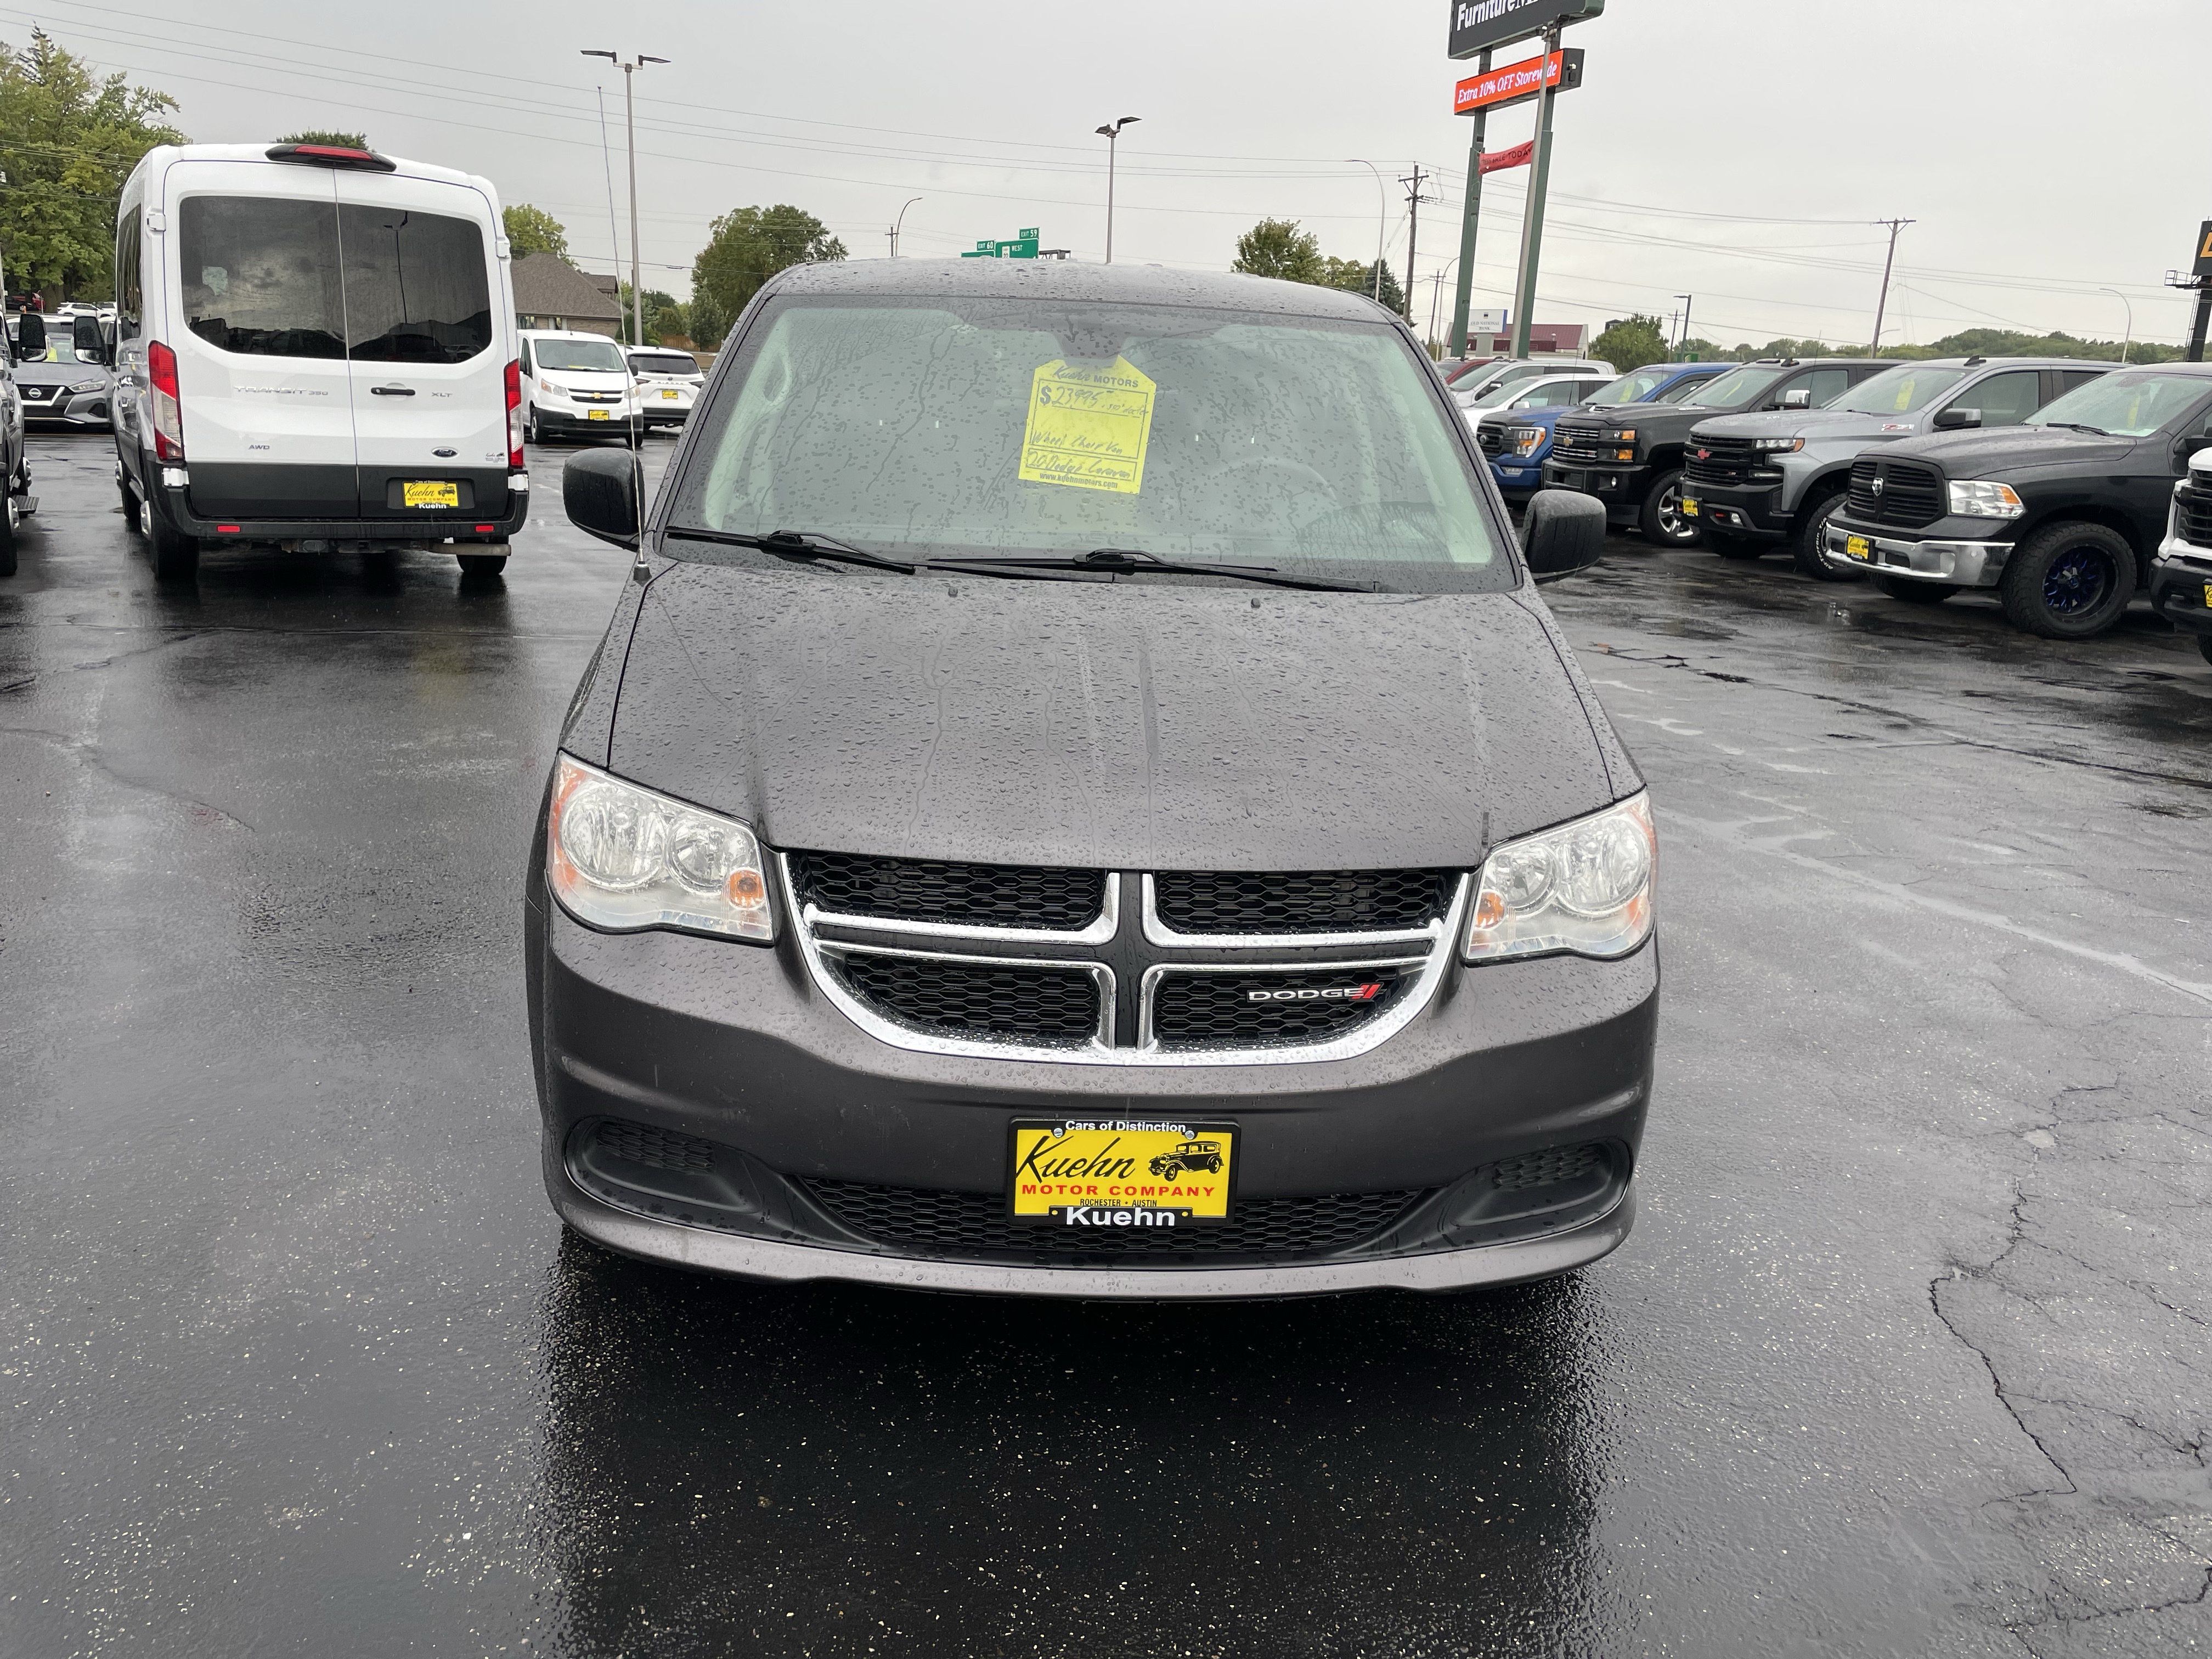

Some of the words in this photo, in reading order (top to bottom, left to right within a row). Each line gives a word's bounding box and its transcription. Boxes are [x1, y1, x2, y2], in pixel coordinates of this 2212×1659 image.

[1457, 88, 1477, 104] Extra
[1479, 80, 1496, 98] 10%
[1497, 74, 1515, 92] OFF
[1515, 61, 1558, 87] Storewde
[1094, 375, 1138, 387] MOTORS
[234, 386, 307, 394] TRANSIT
[1040, 473, 1118, 489] www.kuehnmotors.com
[405, 484, 436, 498] Kuehn
[1249, 987, 1364, 1001] DODGE
[1065, 1120, 1096, 1131] Cars
[1099, 1121, 1113, 1131] of
[1116, 1120, 1186, 1132] Distinction
[1015, 1135, 1135, 1184] Kuehn
[1022, 1184, 1098, 1195] MOTOR
[1109, 1186, 1216, 1197] COMPANY
[1080, 1198, 1121, 1206] ROCHESTER
[1065, 1206, 1175, 1226] Kuehn
